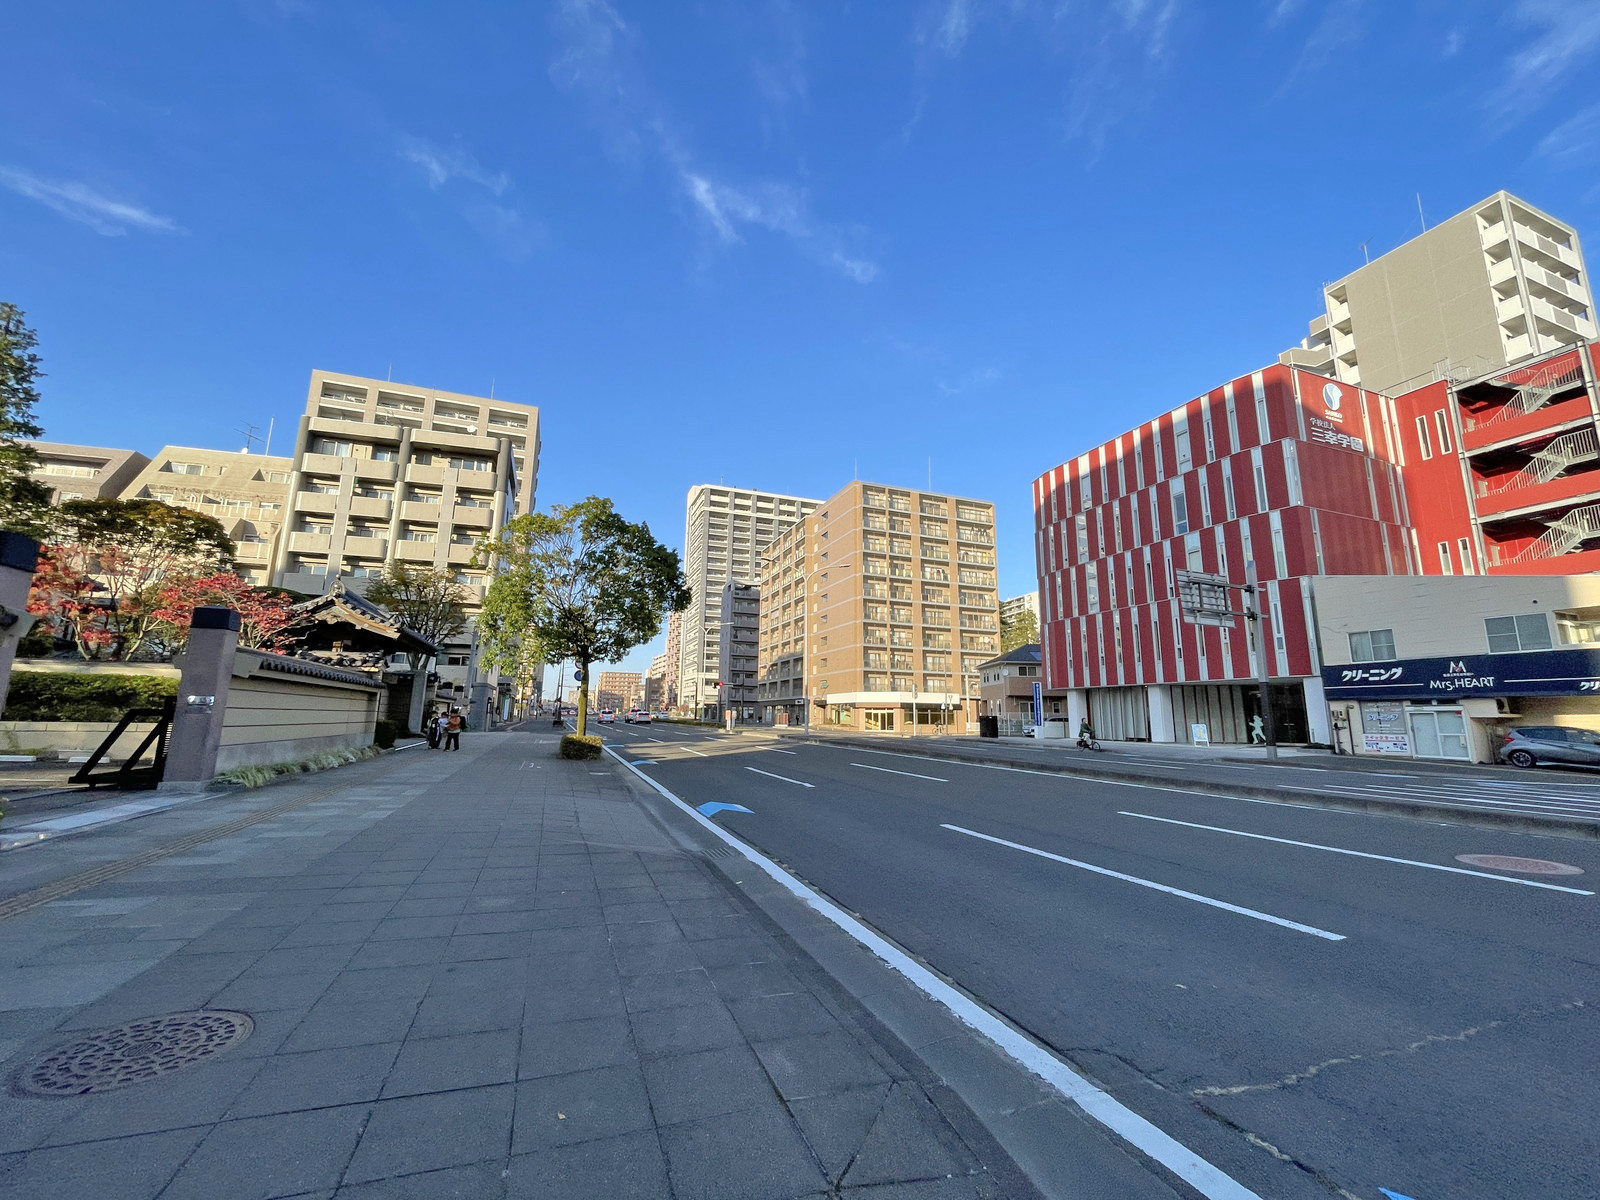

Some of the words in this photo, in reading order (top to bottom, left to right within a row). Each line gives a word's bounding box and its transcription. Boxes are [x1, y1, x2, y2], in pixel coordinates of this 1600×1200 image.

[1311, 427, 1364, 451] 三幸学園
[1341, 667, 1402, 681] クリーニング
[1580, 681, 1600, 691] クリ
